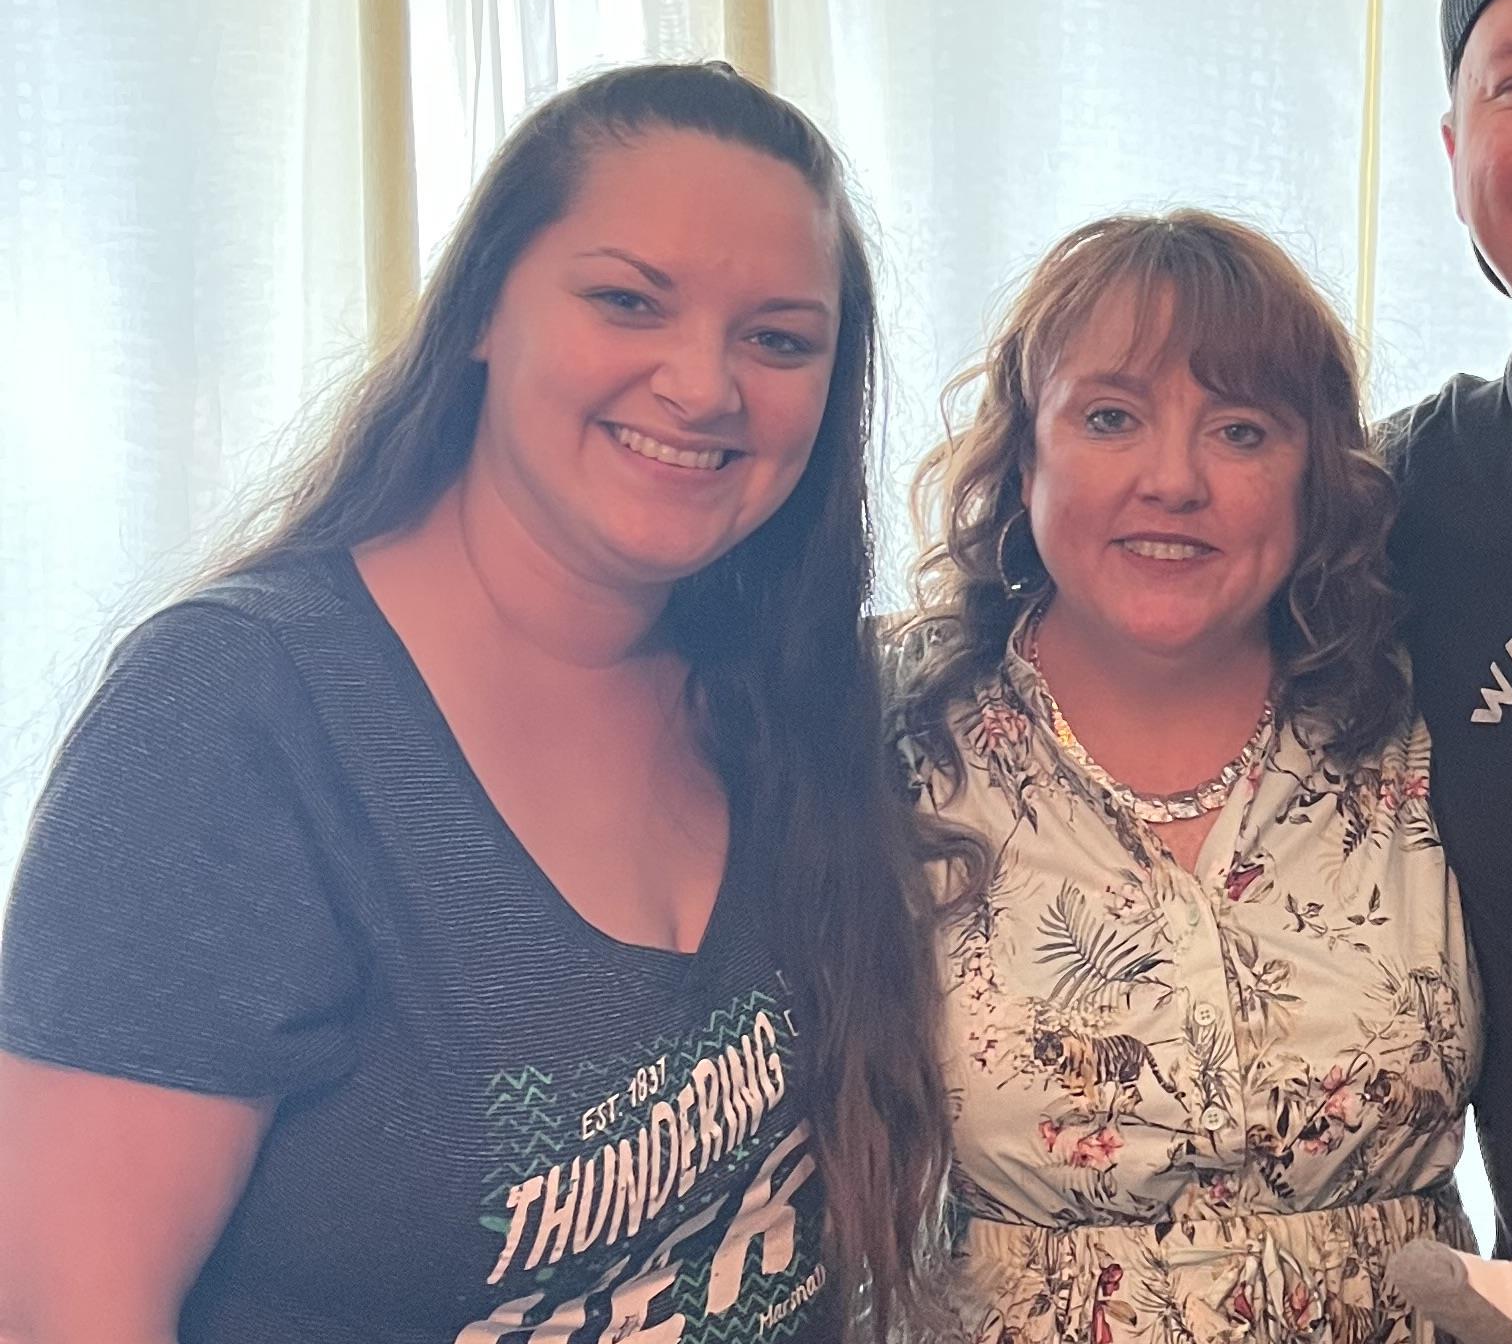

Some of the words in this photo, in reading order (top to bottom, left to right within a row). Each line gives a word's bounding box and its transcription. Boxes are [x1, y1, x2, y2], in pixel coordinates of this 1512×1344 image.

[487, 1010, 785, 1286] THUNDERING
[582, 1093, 623, 1141] EST.
[627, 1054, 667, 1108] 1837
